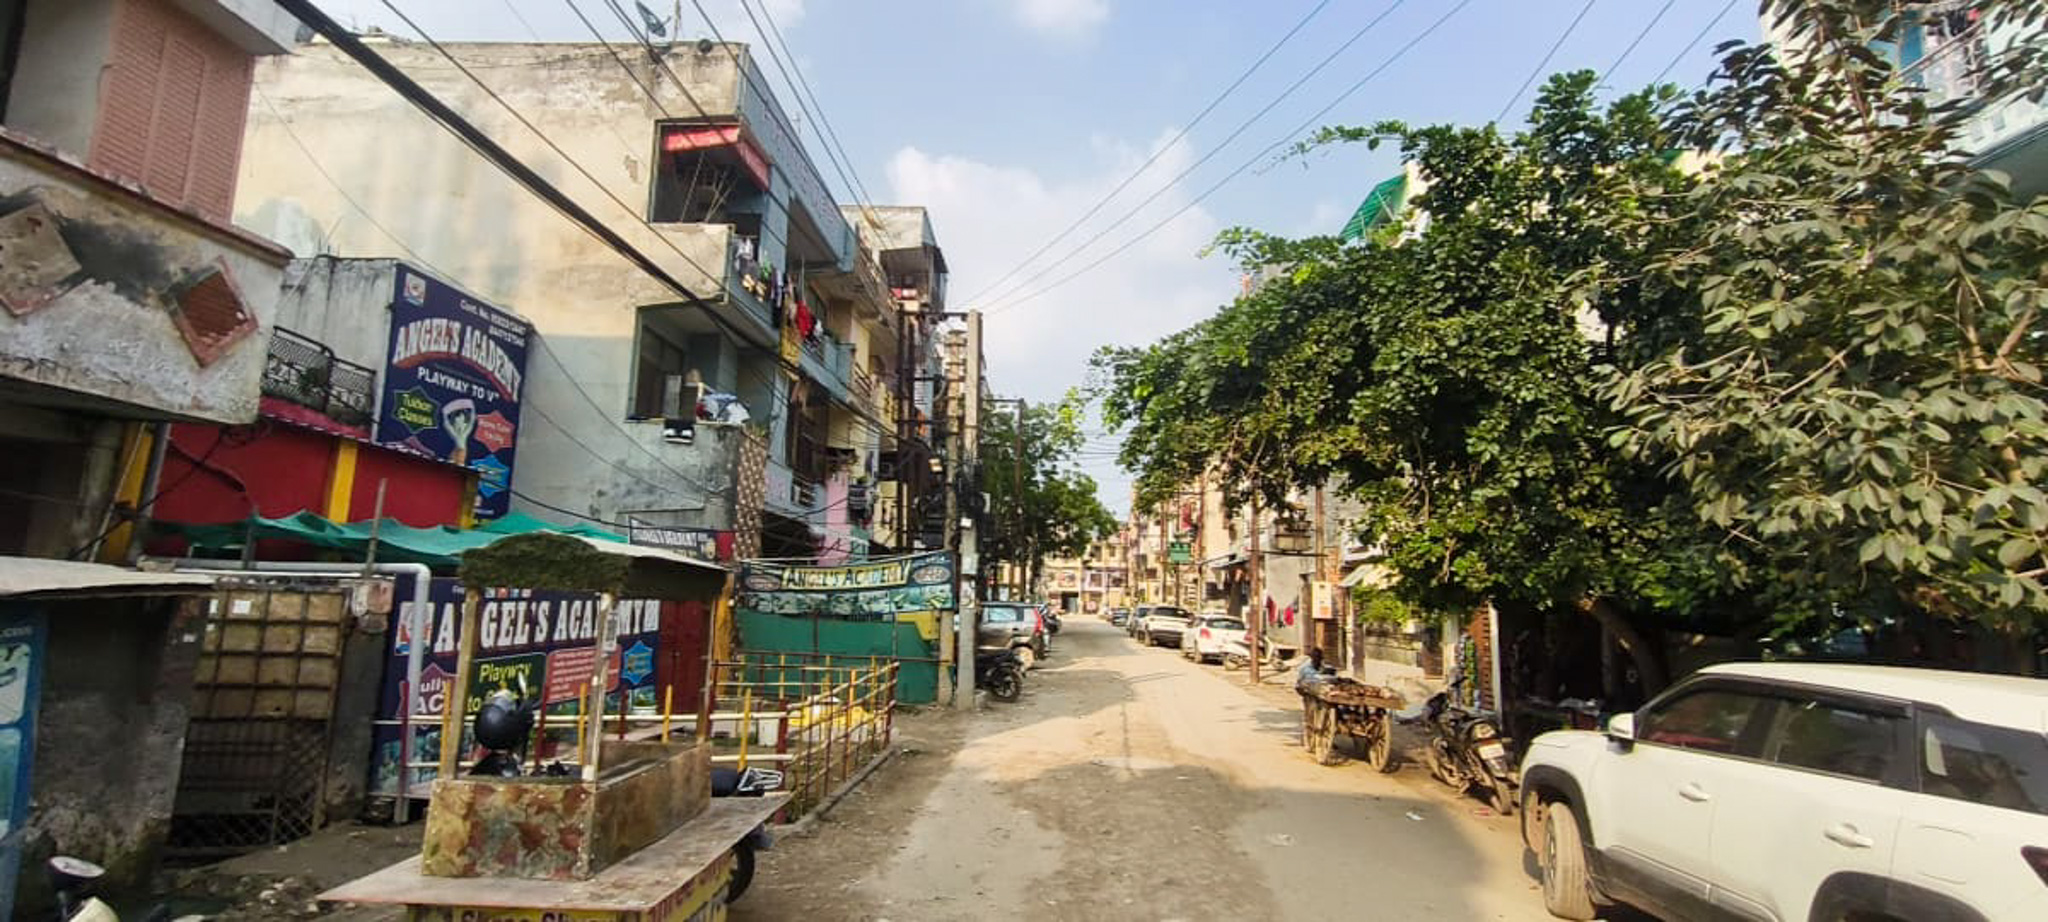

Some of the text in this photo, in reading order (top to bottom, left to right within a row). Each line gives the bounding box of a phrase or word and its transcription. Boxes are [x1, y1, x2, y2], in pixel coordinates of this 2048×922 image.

[392, 317, 521, 403] ANGEL'S ACADEMY
[417, 366, 470, 393] PLAYWAY
[471, 385, 485, 399] TO
[433, 600, 551, 653] AGEL'S
[553, 600, 644, 640] ACAMY
[420, 678, 446, 693] ully
[467, 695, 482, 713] to
